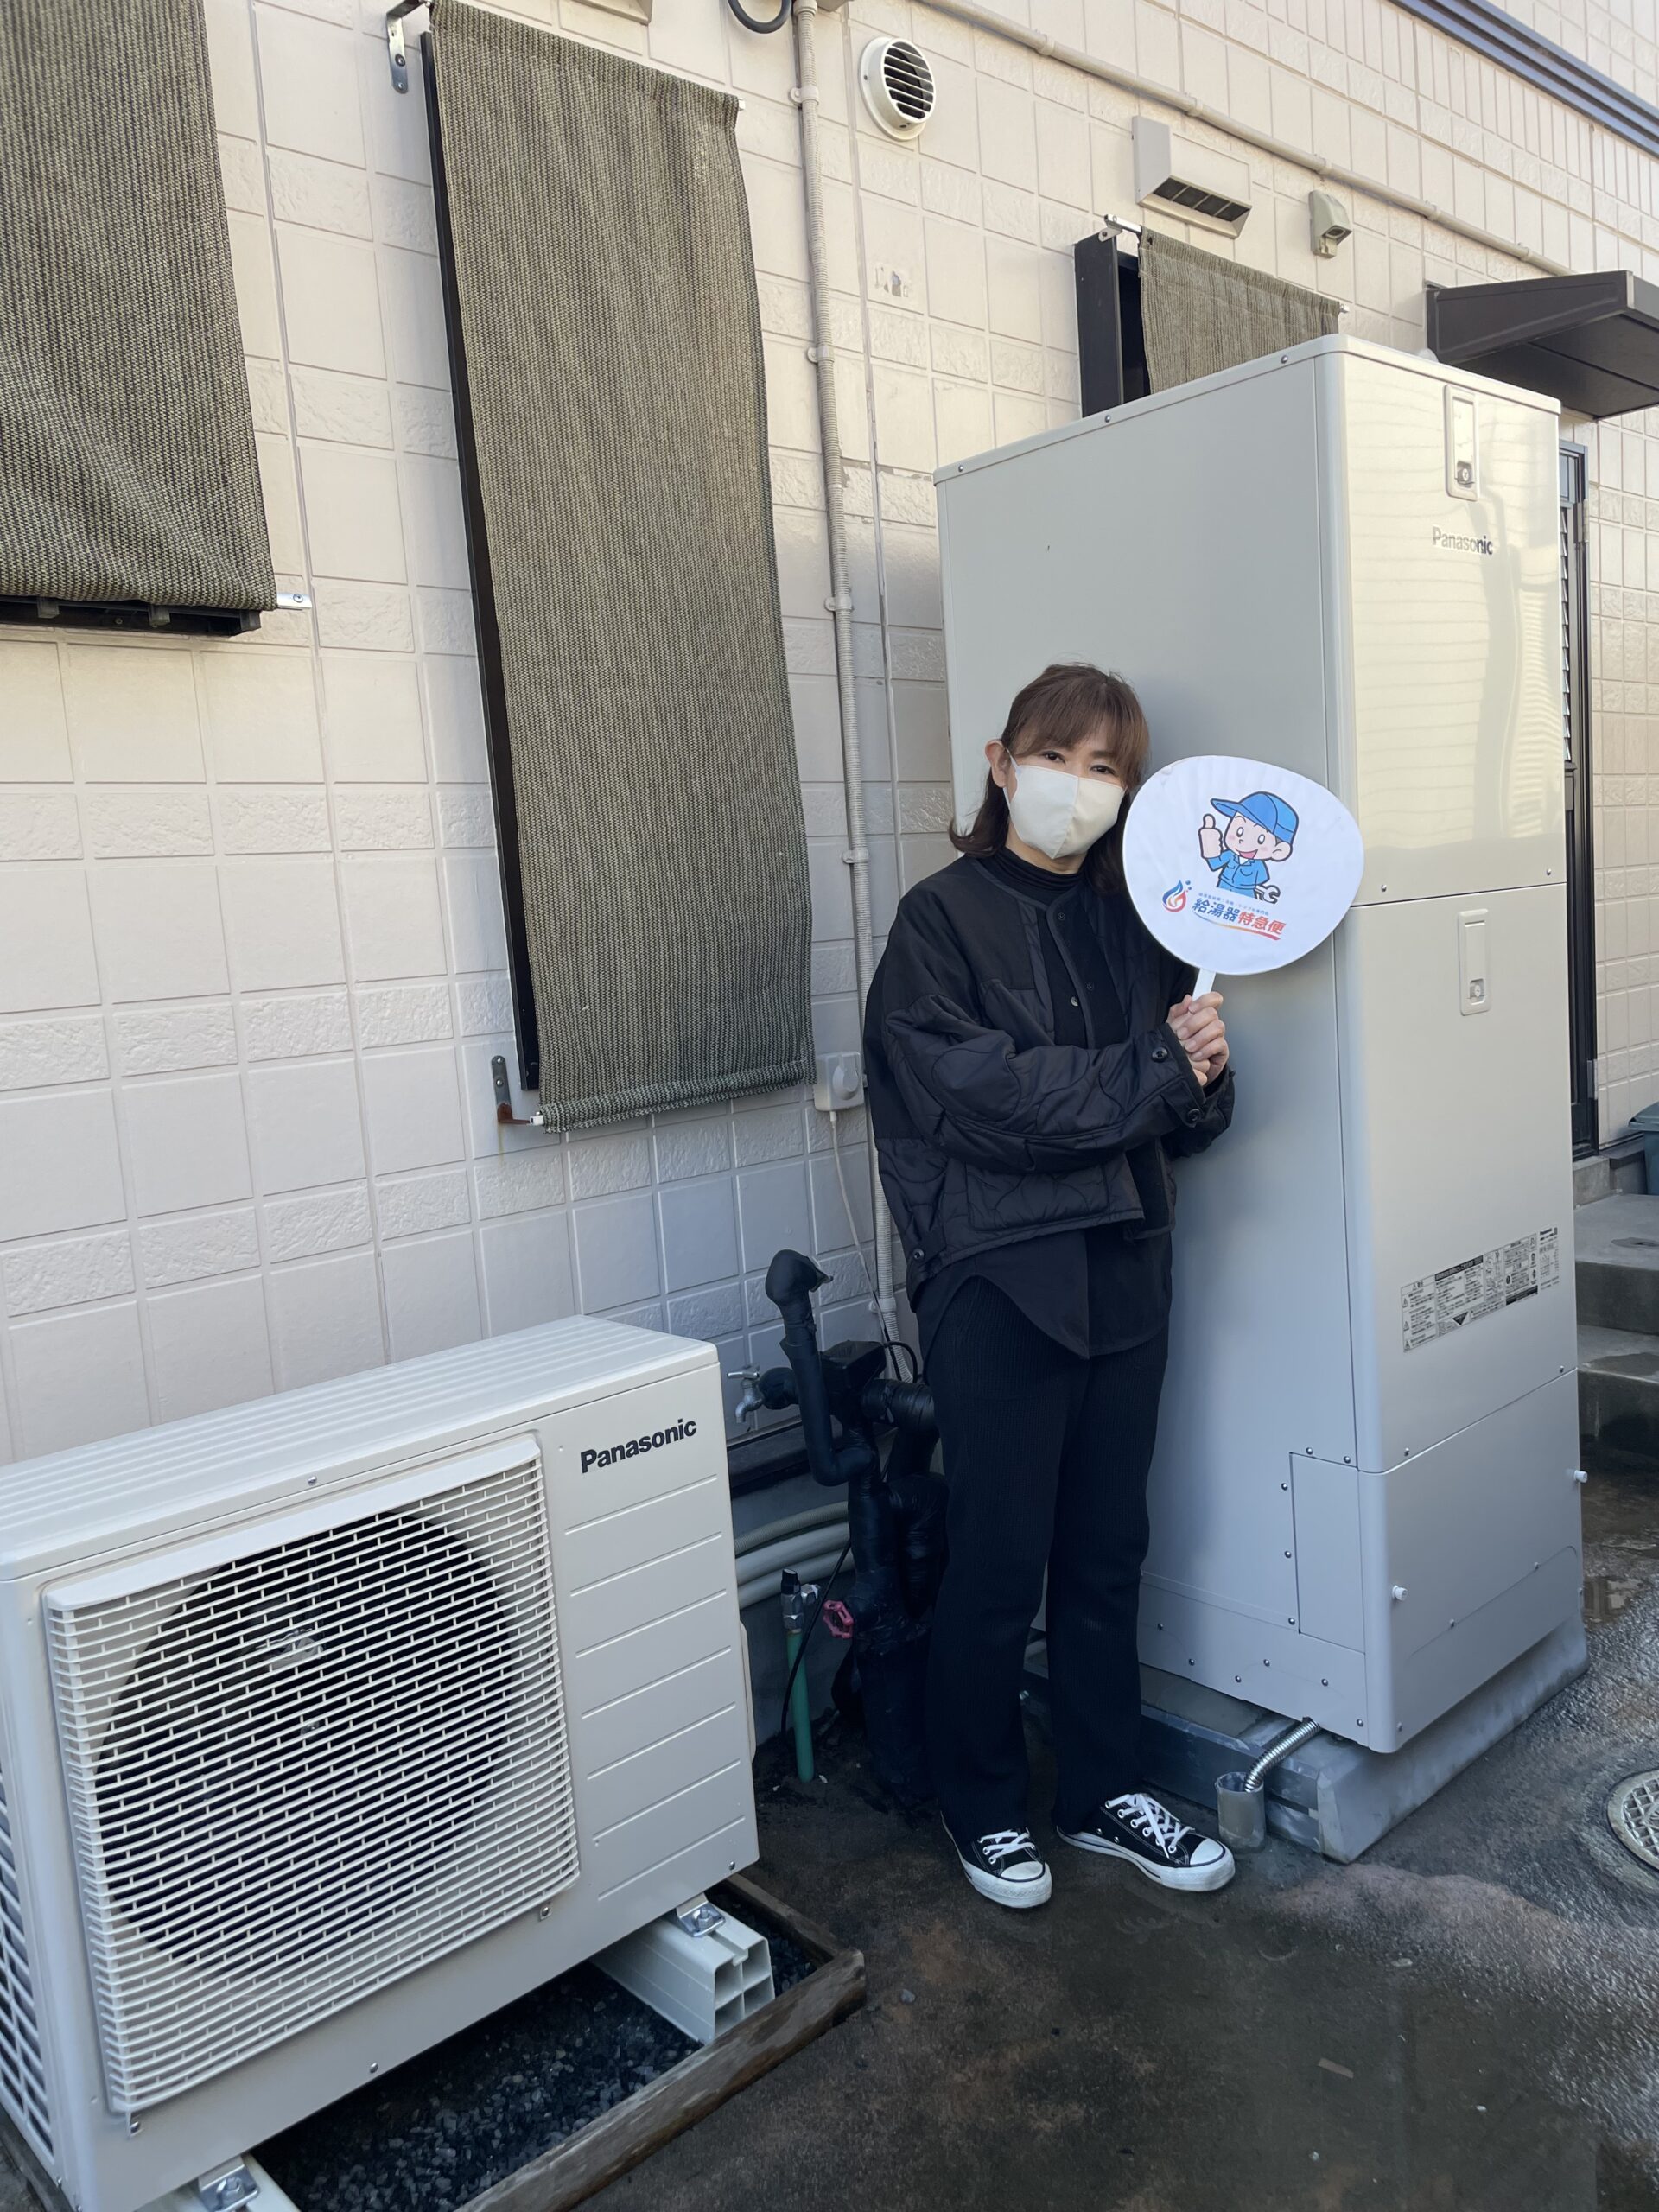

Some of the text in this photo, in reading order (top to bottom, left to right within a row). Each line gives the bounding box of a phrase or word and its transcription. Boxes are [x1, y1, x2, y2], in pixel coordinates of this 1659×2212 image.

[1433, 526, 1494, 555] Panasonic
[1192, 898, 1287, 935] 給湯器特急便
[580, 1418, 697, 1474] Panasonic
